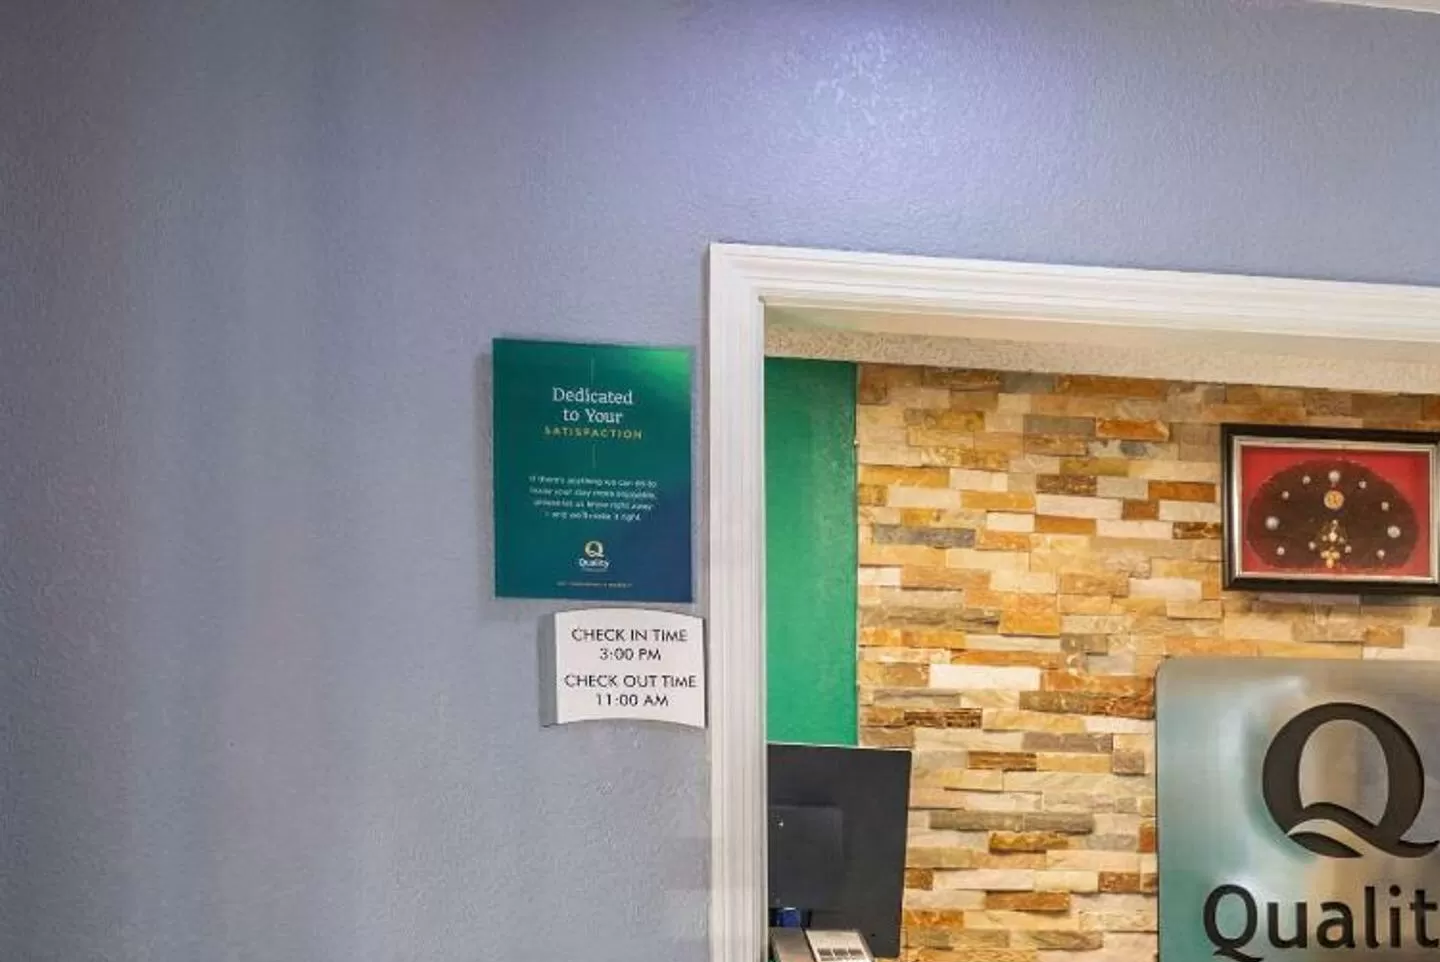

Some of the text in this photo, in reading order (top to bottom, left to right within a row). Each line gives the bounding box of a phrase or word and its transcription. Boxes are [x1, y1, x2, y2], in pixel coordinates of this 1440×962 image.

[552, 386, 633, 405] Dedicated
[563, 408, 624, 424] to Your
[544, 425, 642, 440] SATISFACTION
[578, 558, 610, 569] Quality
[571, 628, 688, 642] CHECK IN TIME
[599, 647, 661, 661] 3:00 PM
[564, 674, 698, 688] CHECK OUT TIME
[596, 693, 669, 707] 11:00 AM
[1262, 701, 1440, 859] Q
